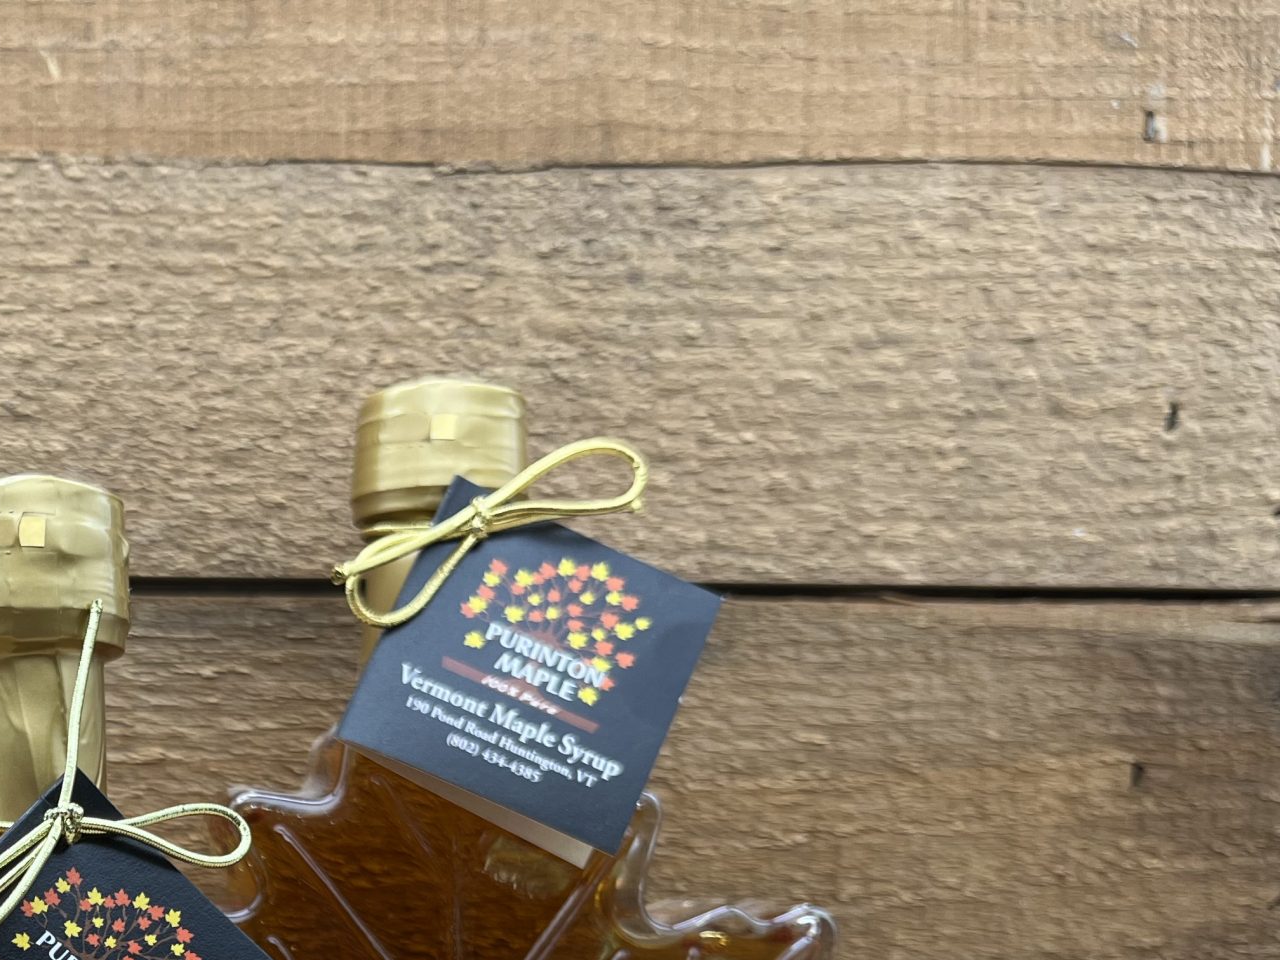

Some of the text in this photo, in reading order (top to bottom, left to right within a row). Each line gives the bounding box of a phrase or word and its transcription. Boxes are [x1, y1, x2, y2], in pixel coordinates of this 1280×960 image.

[485, 622, 606, 688] PURINTON
[494, 650, 578, 701] MAPLE
[401, 662, 624, 781] Vermont Maple Syrup
[519, 692, 561, 715] Pure
[406, 695, 598, 788] 190 Pond Road Huntington, VT
[446, 732, 542, 783] (802) 434-4385
